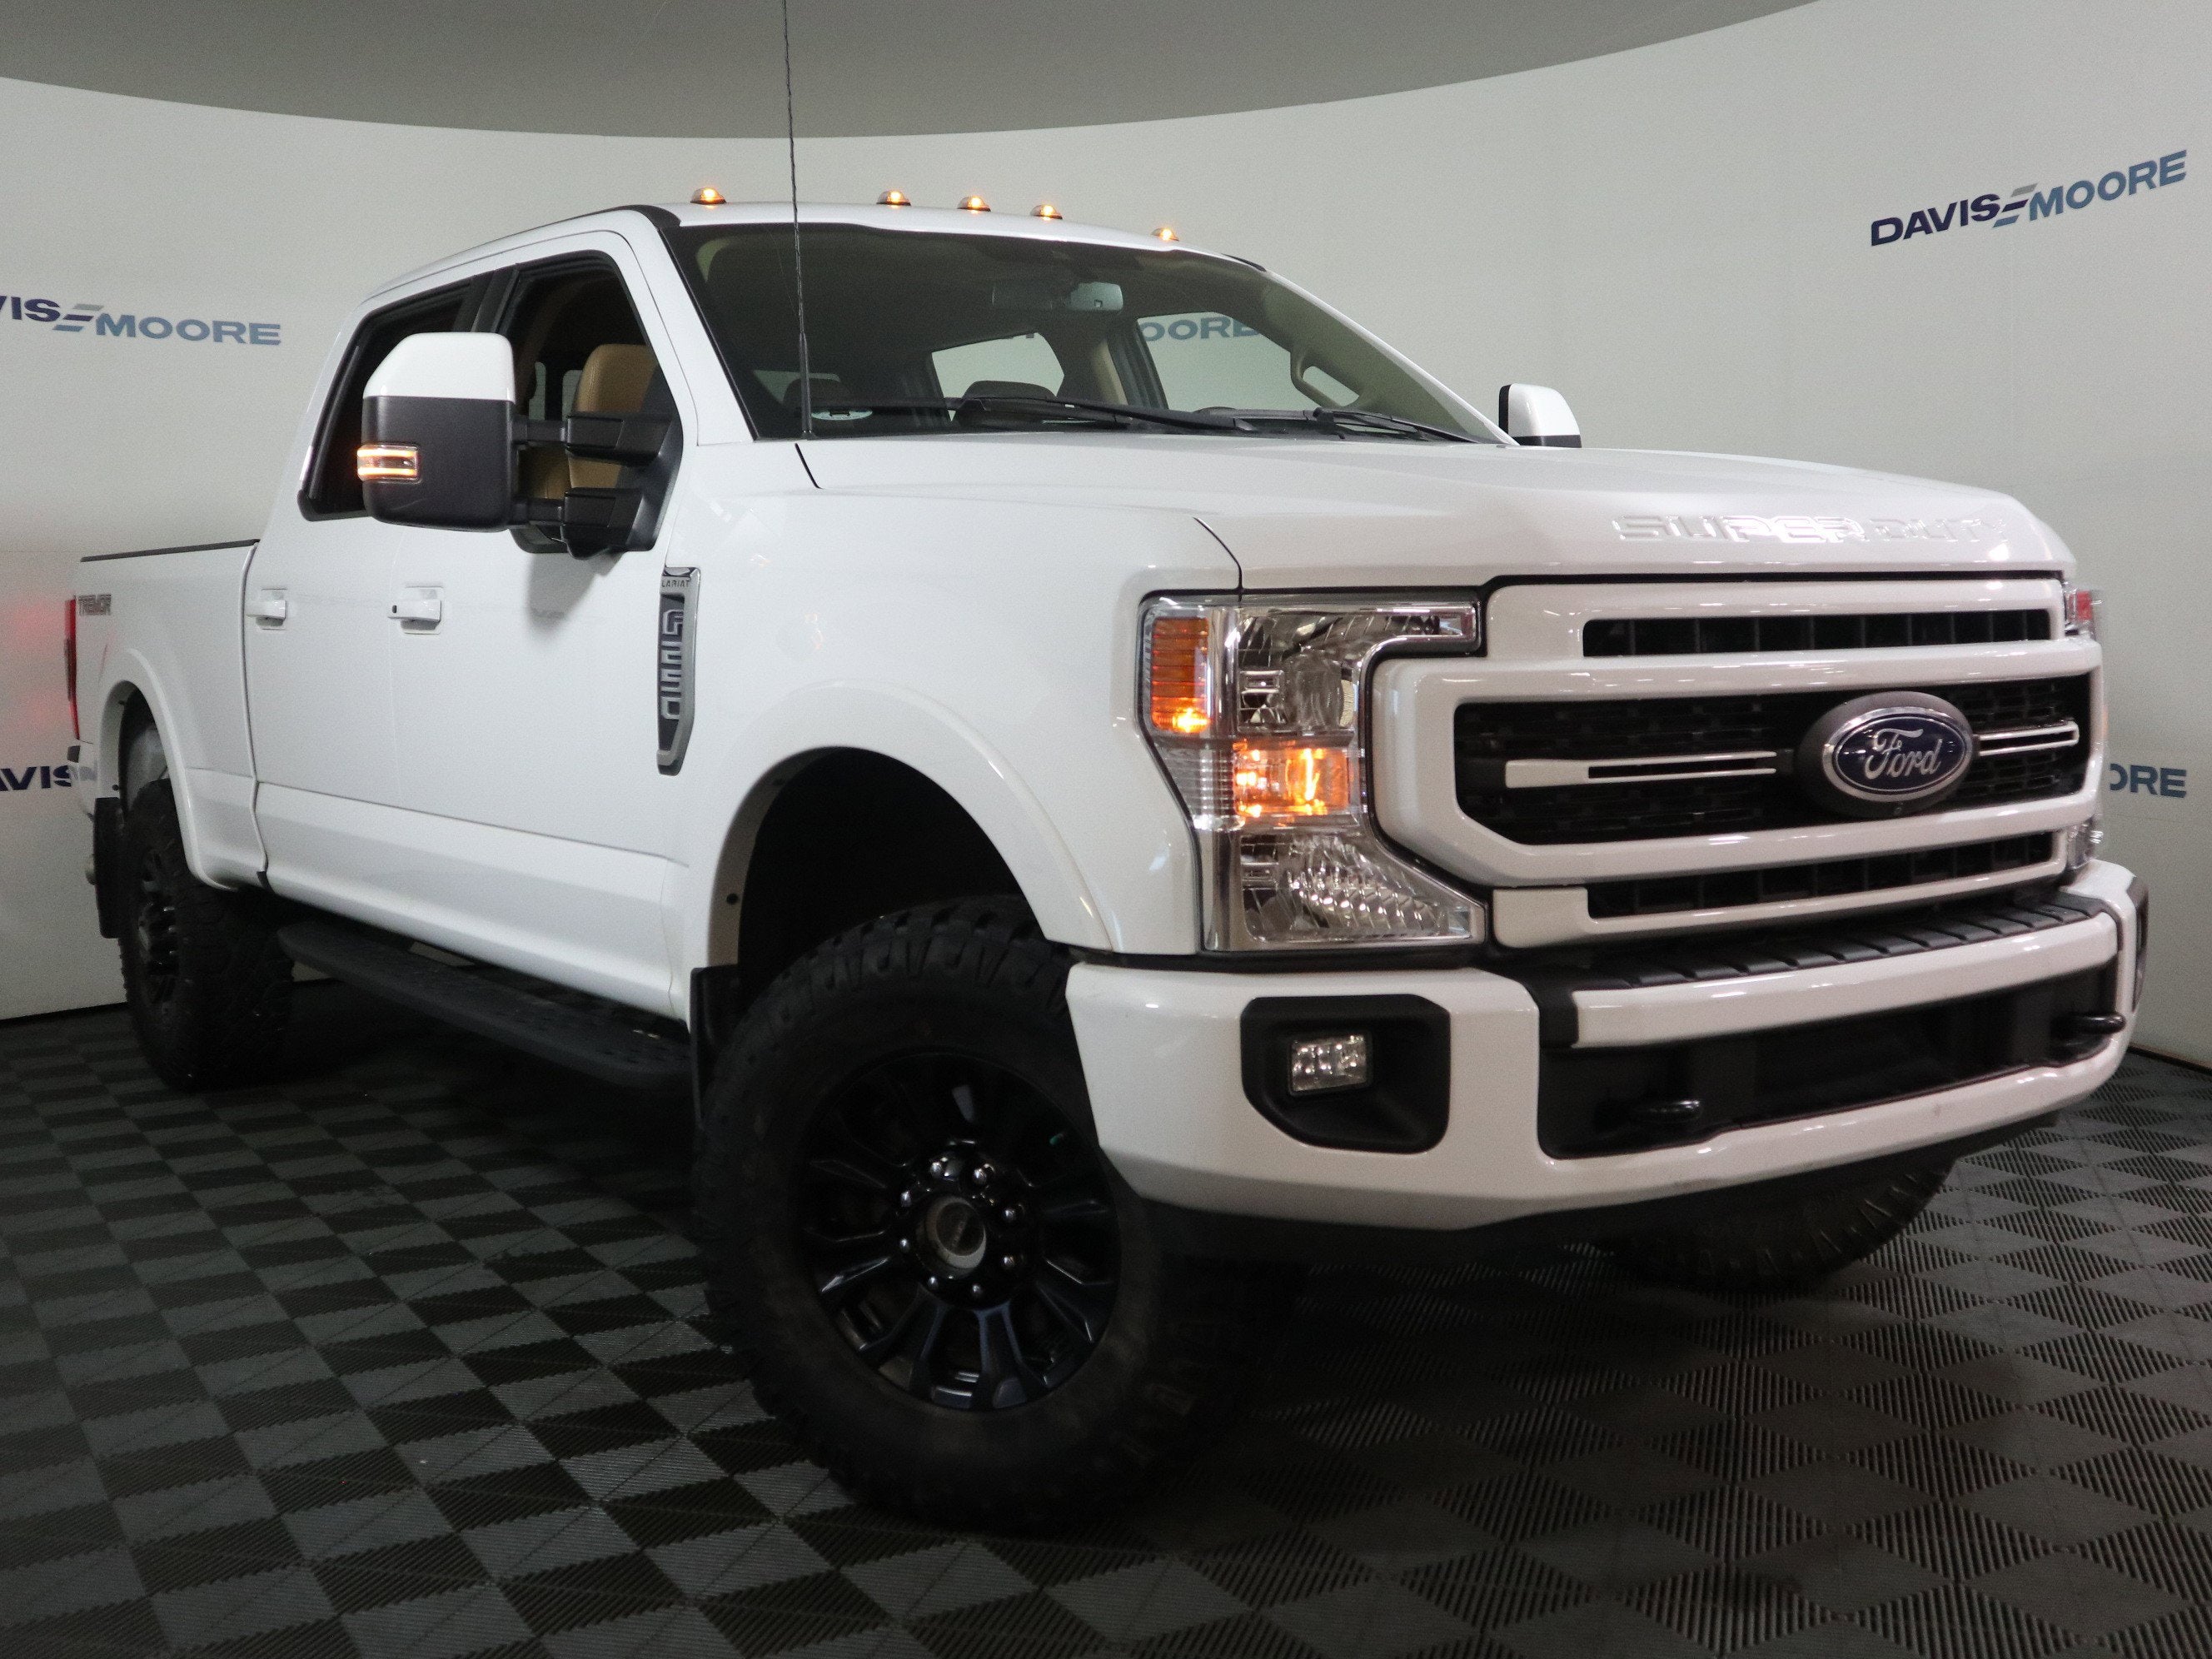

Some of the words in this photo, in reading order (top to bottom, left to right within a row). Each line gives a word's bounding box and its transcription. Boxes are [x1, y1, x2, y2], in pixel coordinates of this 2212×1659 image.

[1871, 192, 2001, 247] DAVIS
[2028, 148, 2188, 222] MOORE
[95, 312, 281, 346] MOORE
[1612, 515, 1871, 543] SUPER
[660, 579, 690, 588] LARIAT
[1864, 728, 1944, 780] Ford
